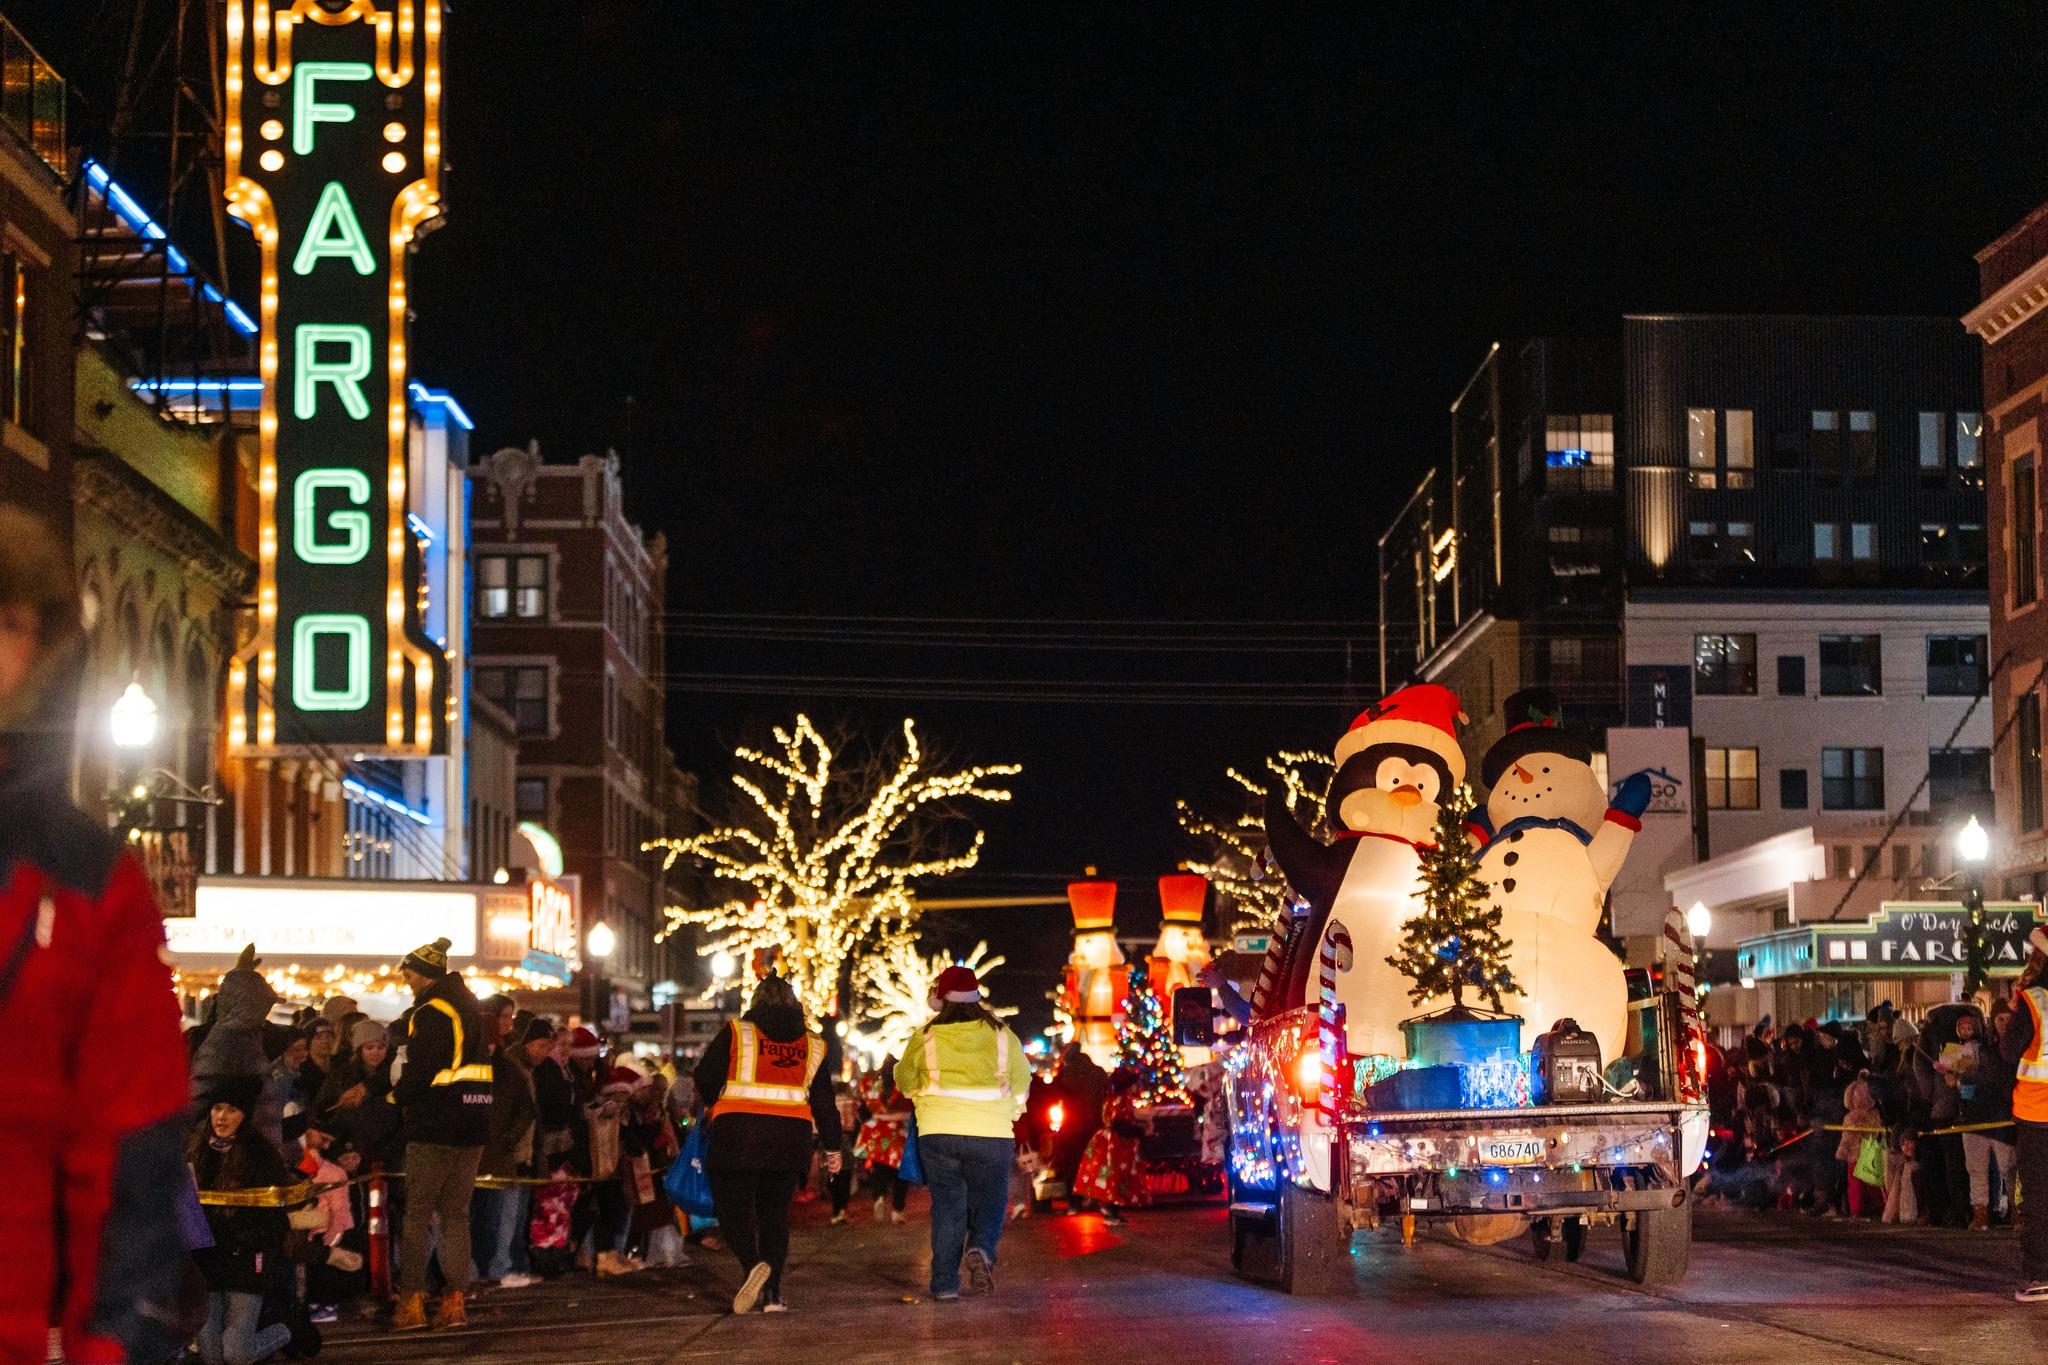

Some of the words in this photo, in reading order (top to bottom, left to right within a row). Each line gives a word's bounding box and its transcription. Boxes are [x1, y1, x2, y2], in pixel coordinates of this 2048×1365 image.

[293, 61, 376, 711] FARGO
[1881, 940, 2034, 962] FARGAN
[758, 1039, 807, 1059] Fargo
[1490, 1143, 1540, 1158] G86740
